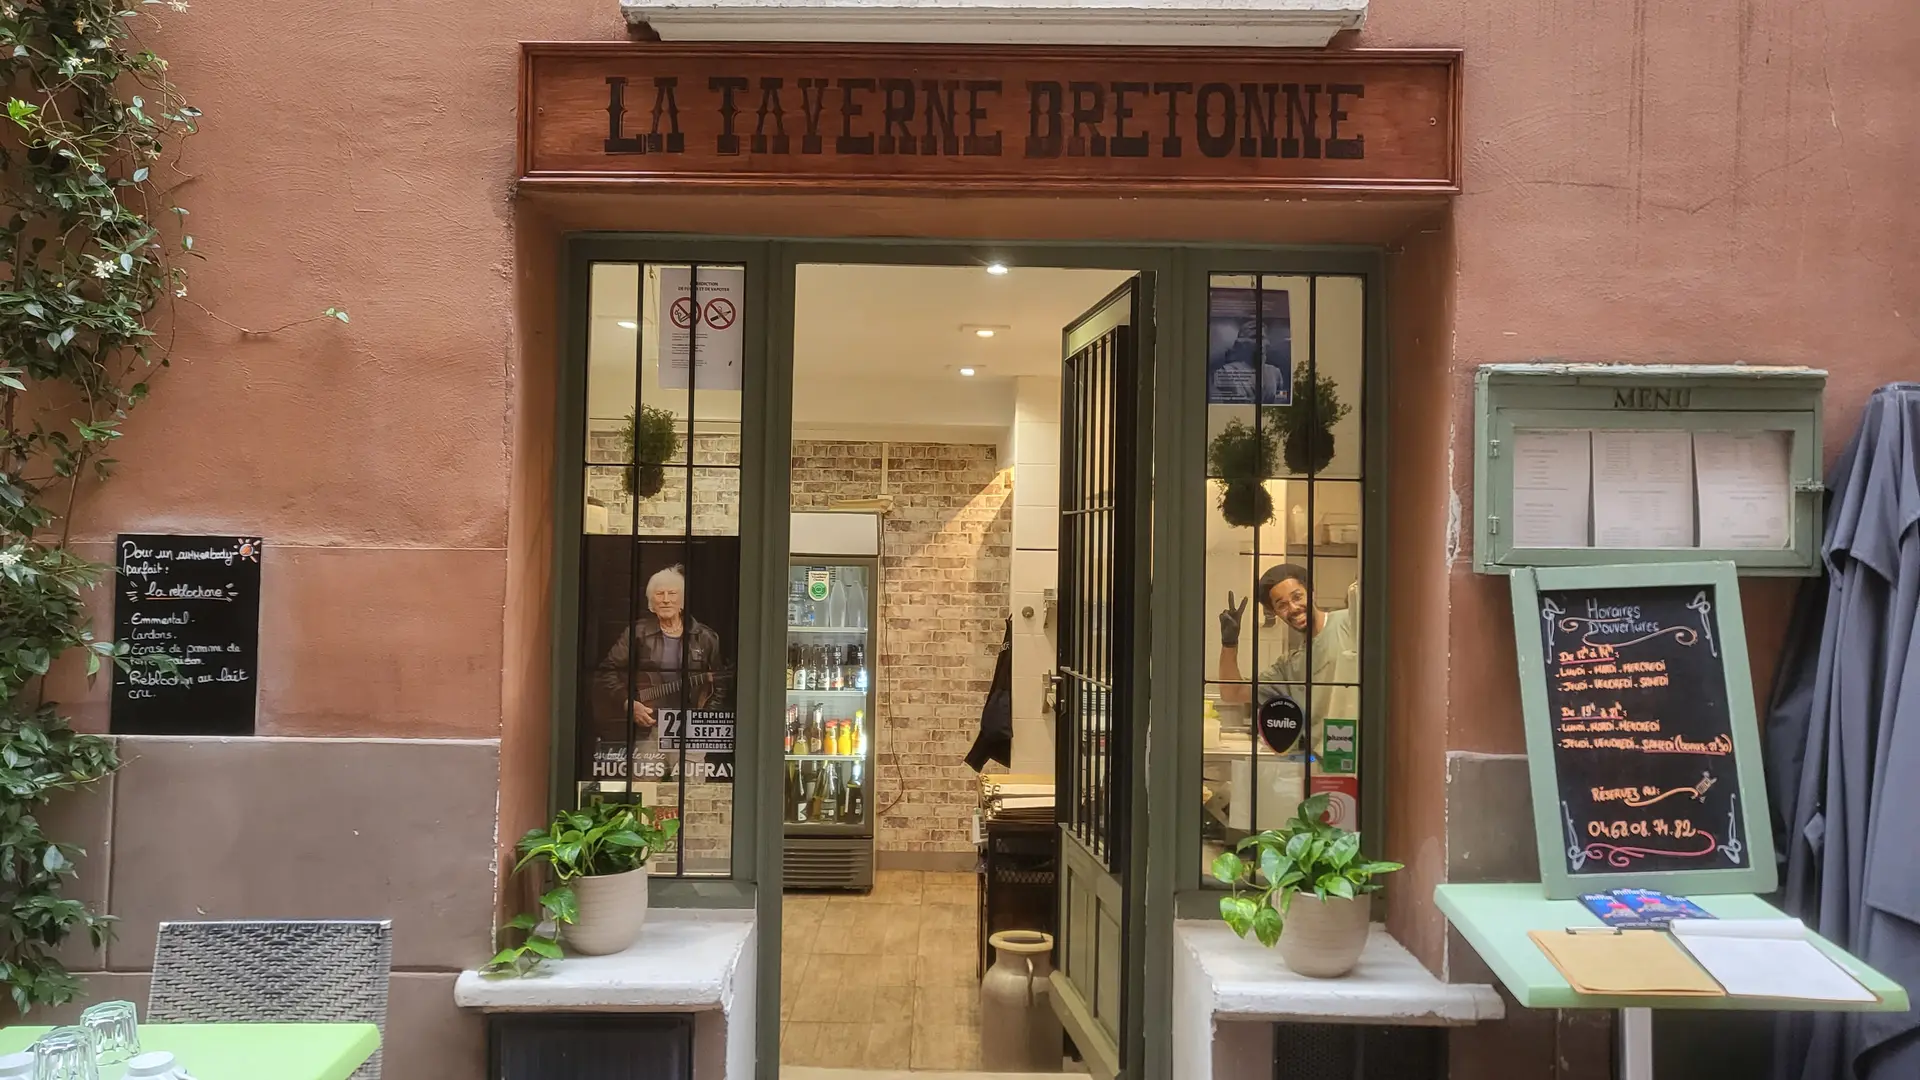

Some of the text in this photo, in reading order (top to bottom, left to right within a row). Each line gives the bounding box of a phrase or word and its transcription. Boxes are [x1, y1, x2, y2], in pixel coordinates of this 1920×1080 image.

[604, 76, 1366, 160] LA TAVERNE BRETONNE
[1614, 388, 1691, 408] MENU
[122, 541, 153, 573] Pour
[155, 550, 173, 561] un
[144, 582, 167, 596] la
[1587, 598, 1641, 619] Horaires
[1588, 619, 1660, 635] D'ouvertures
[169, 644, 182, 653] de
[187, 645, 224, 658] pomme
[227, 643, 242, 652] de
[197, 675, 215, 683] au
[216, 667, 249, 682] lait
[1266, 717, 1297, 729] swile
[643, 752, 667, 761] avec
[593, 762, 665, 777] HUGUES
